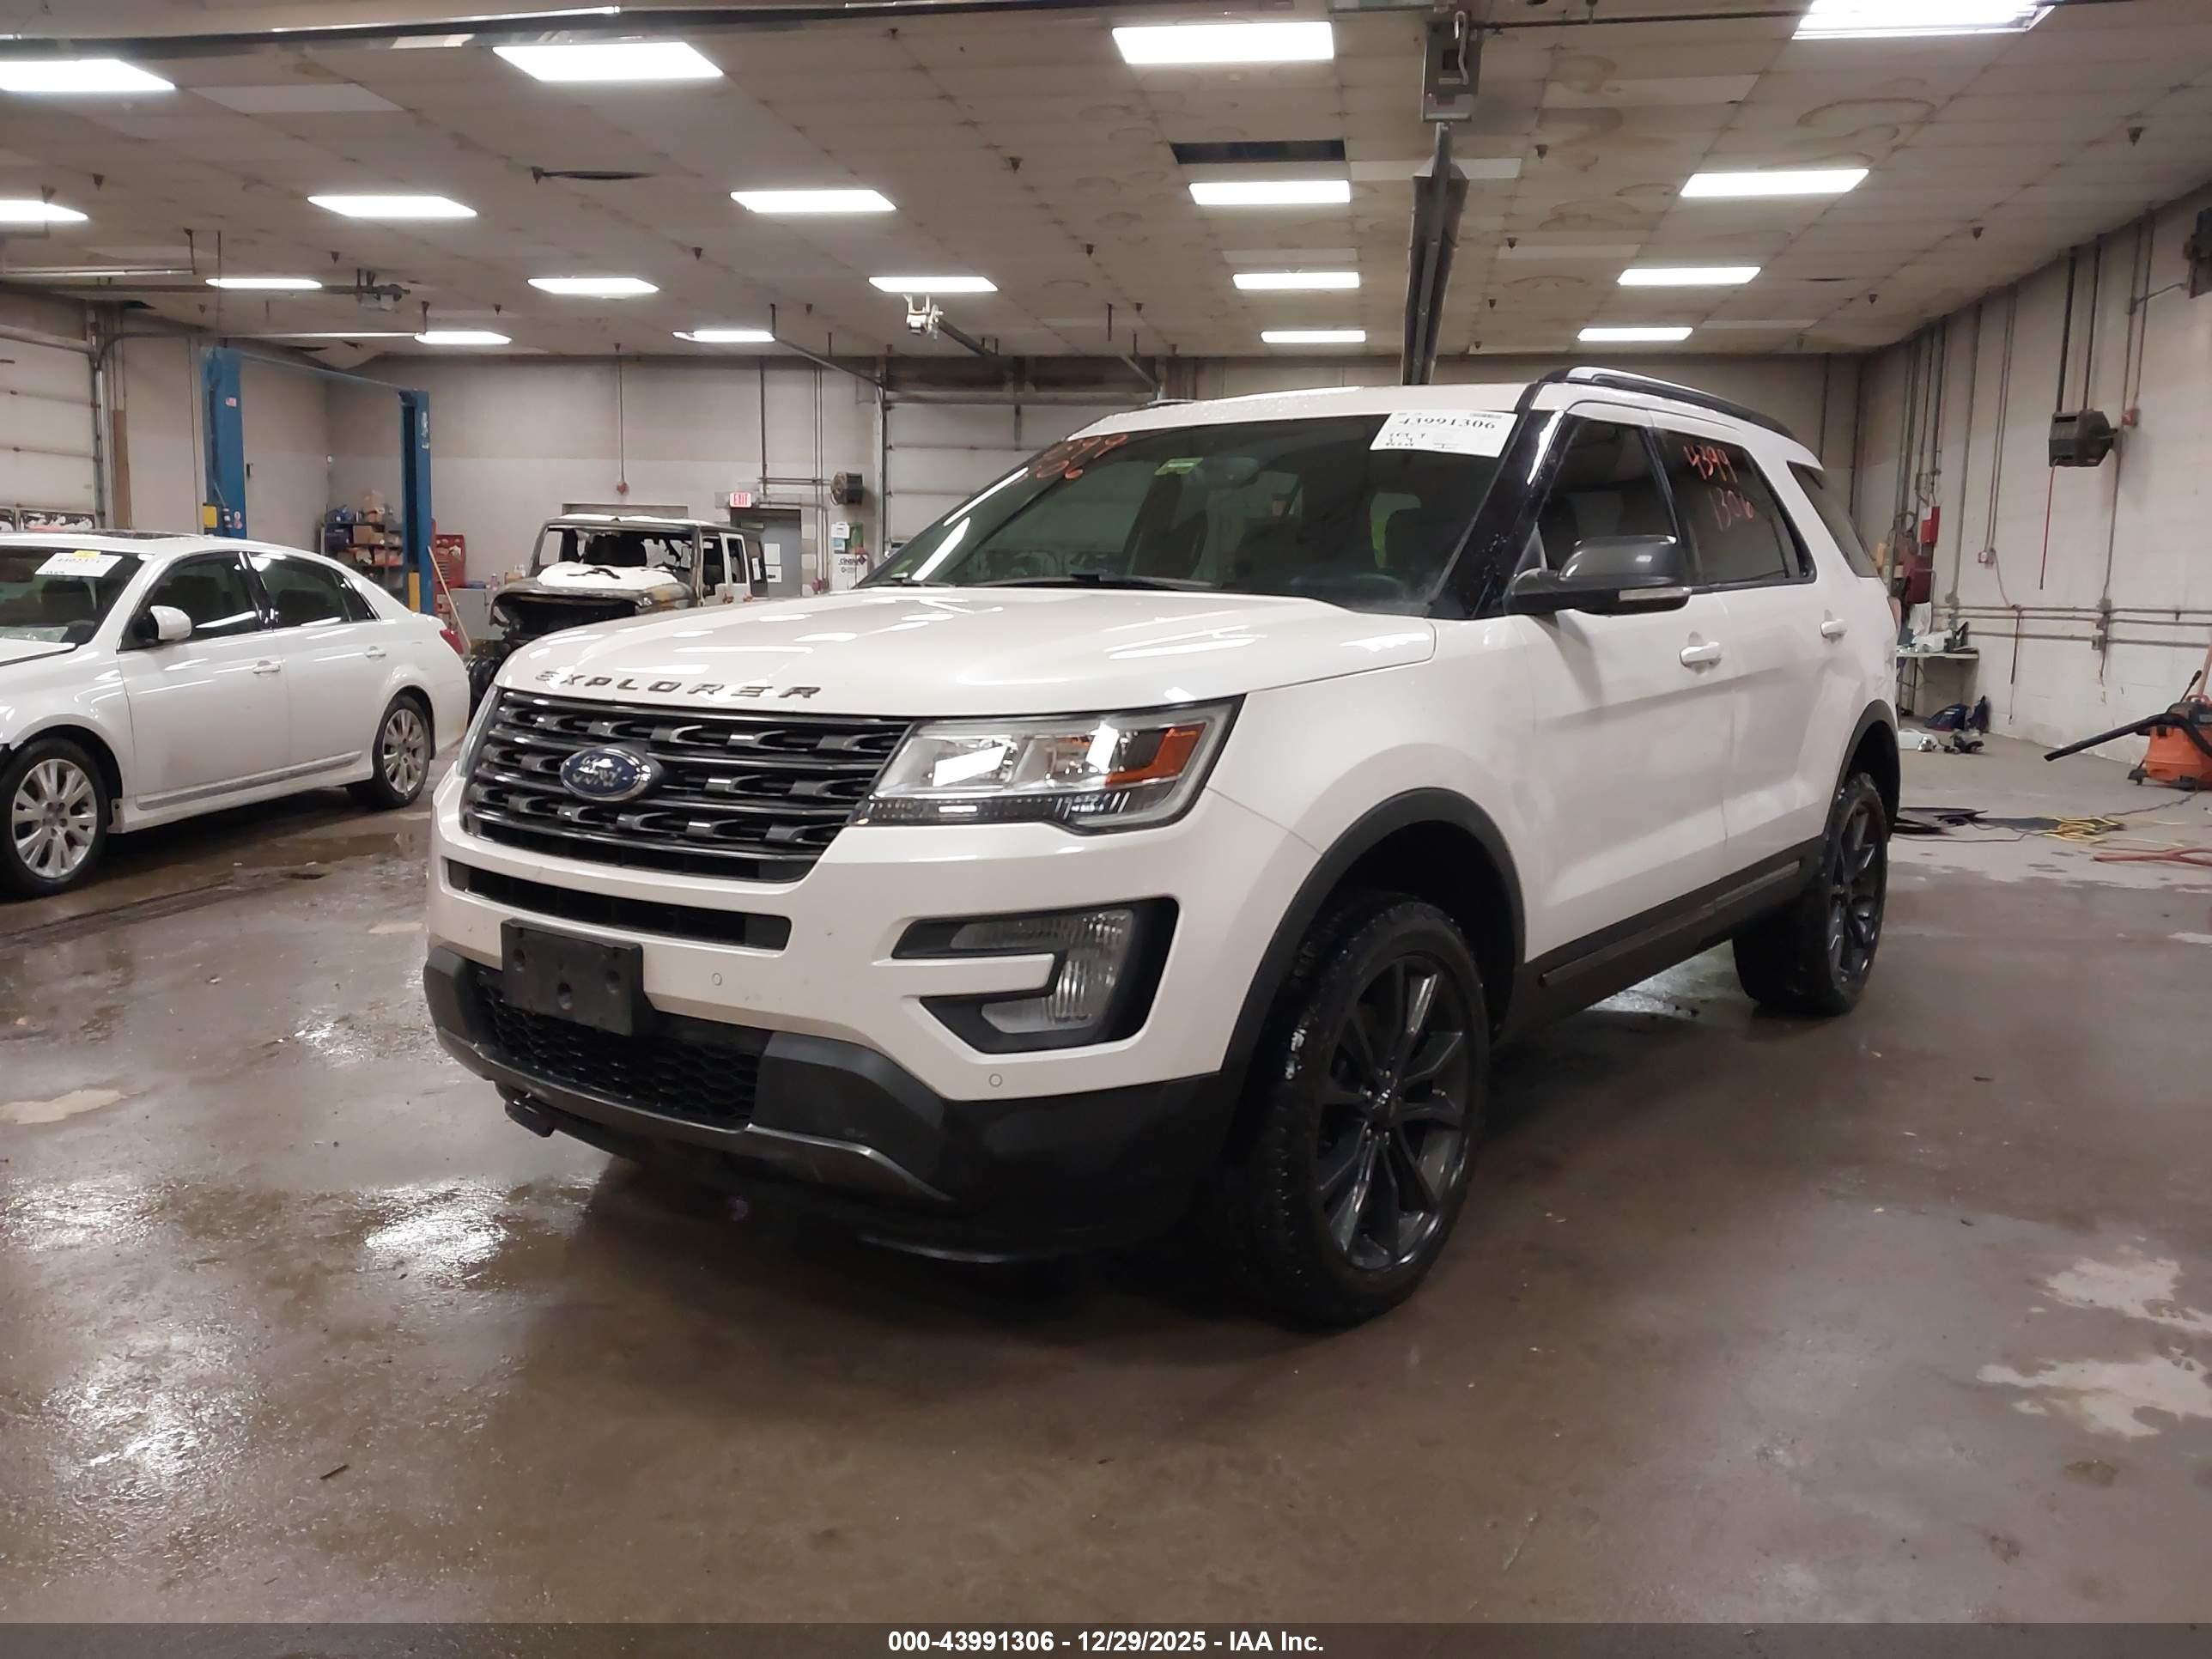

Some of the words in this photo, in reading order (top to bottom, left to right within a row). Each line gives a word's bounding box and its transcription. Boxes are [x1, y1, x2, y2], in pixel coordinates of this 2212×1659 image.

[1398, 416, 1497, 429] 43991306
[733, 494, 748, 506] EXIT
[535, 670, 822, 699] EXPLORER
